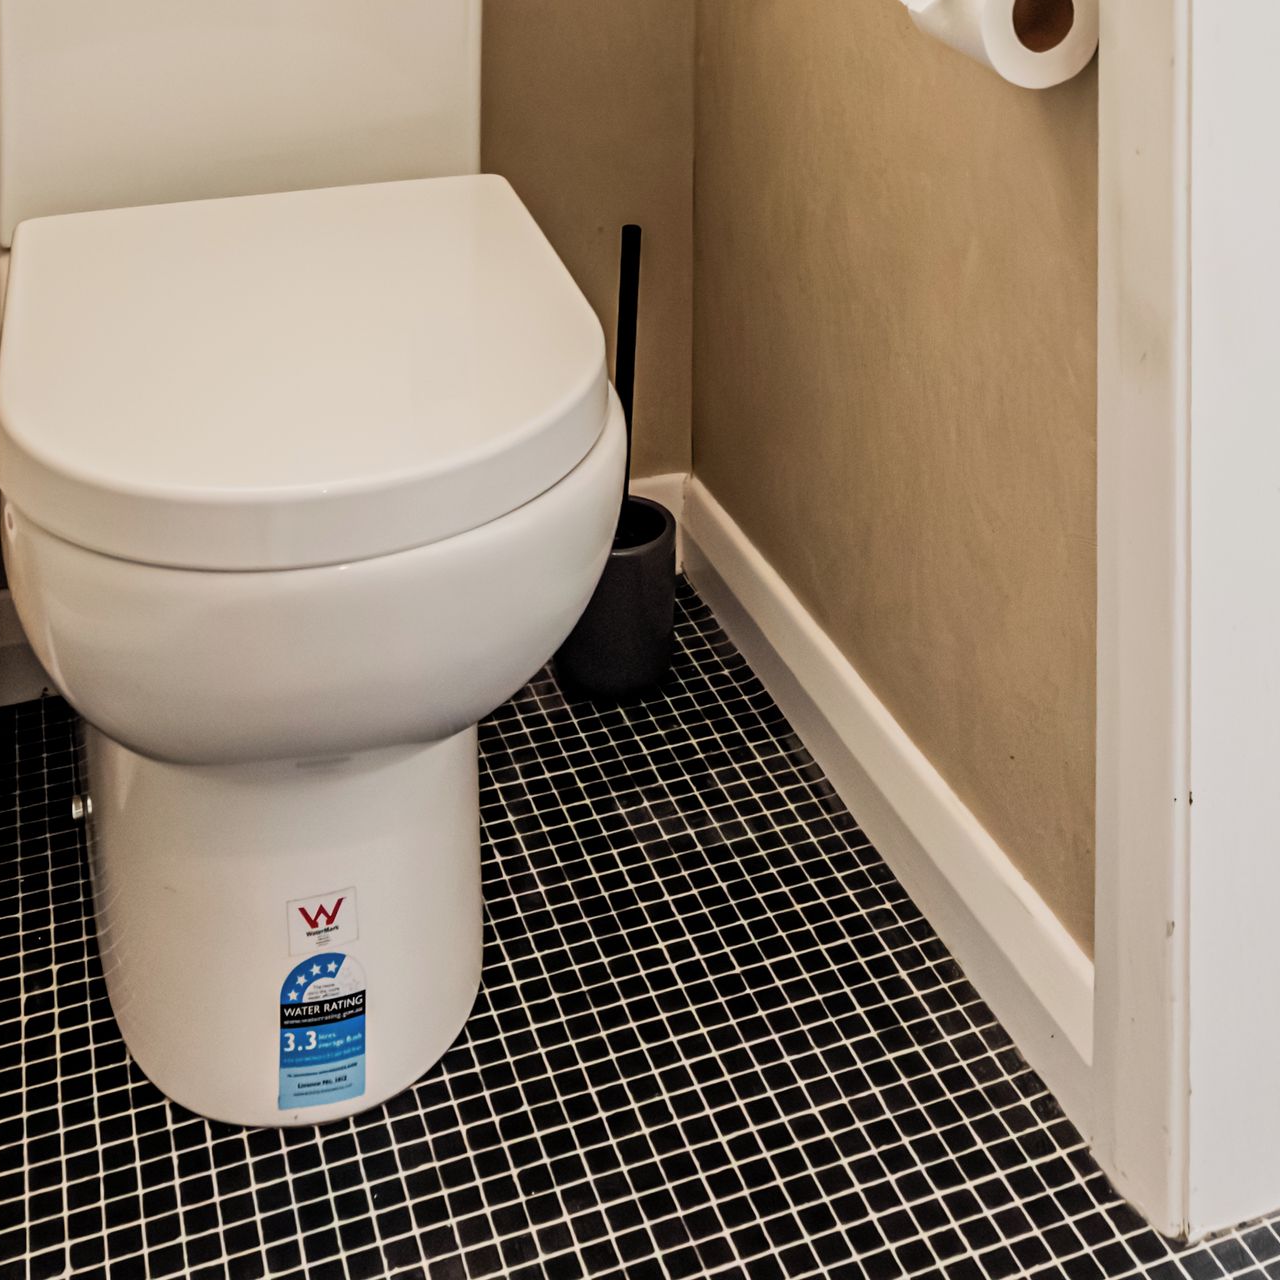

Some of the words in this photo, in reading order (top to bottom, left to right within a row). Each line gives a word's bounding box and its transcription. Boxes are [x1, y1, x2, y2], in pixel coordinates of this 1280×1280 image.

[306, 925, 340, 937] WaterMark
[284, 1004, 321, 1017] WATER
[324, 994, 363, 1013] RATING
[284, 1030, 317, 1052] 3.3
